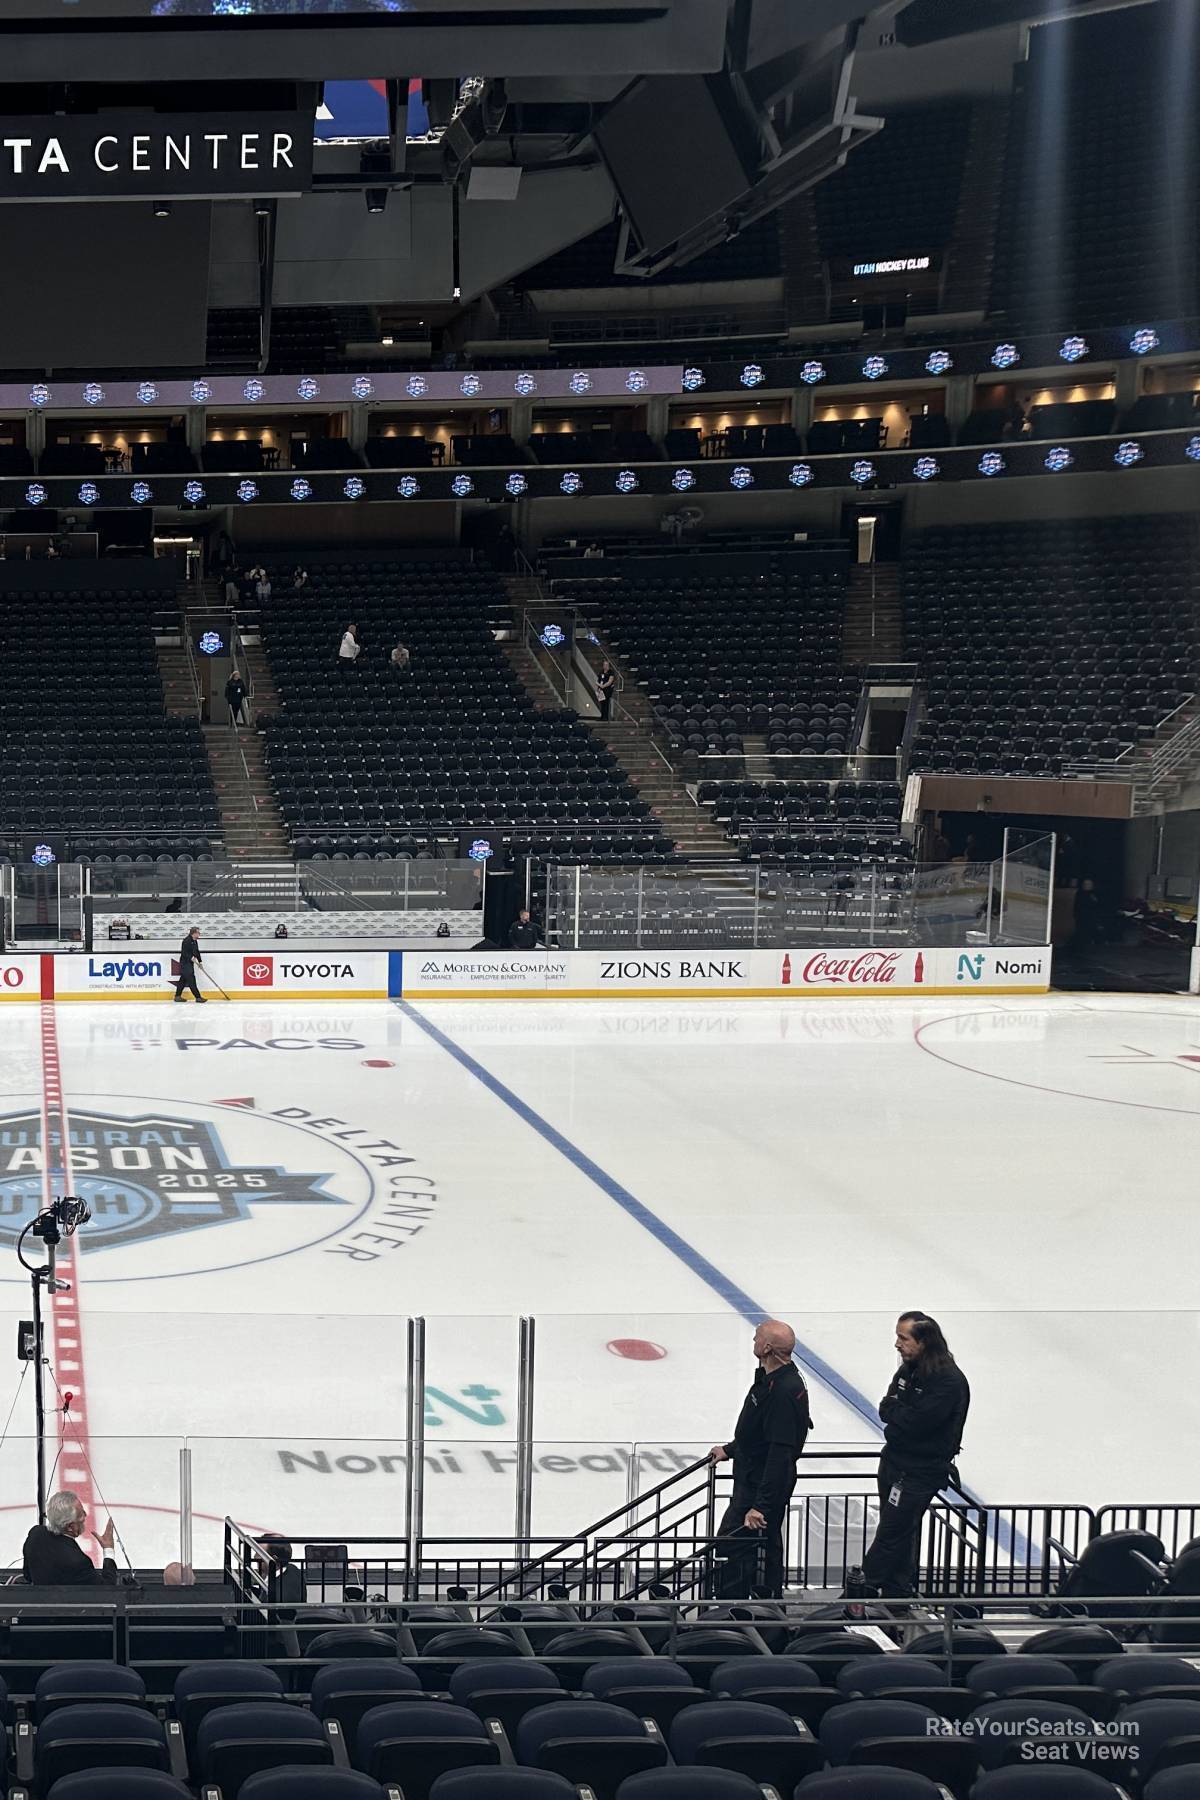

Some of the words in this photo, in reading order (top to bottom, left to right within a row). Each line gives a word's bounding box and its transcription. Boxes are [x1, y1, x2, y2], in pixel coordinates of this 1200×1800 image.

[93, 132, 295, 173] CENTER
[853, 262, 875, 275] UTAH
[875, 259, 907, 273] HOCKEY
[906, 256, 929, 270] CLUB
[88, 958, 162, 982] Layton
[280, 964, 354, 979] TOYOTA
[600, 961, 671, 979] ZIONS
[678, 961, 743, 978] BANK
[994, 959, 1042, 975] Nomi
[175, 1037, 367, 1051] PACS
[268, 1106, 417, 1168] DELTA
[156, 1173, 268, 1189] 2025
[322, 1175, 437, 1262] CENTER
[276, 1448, 466, 1475] Nomi
[480, 1447, 708, 1475] Health
